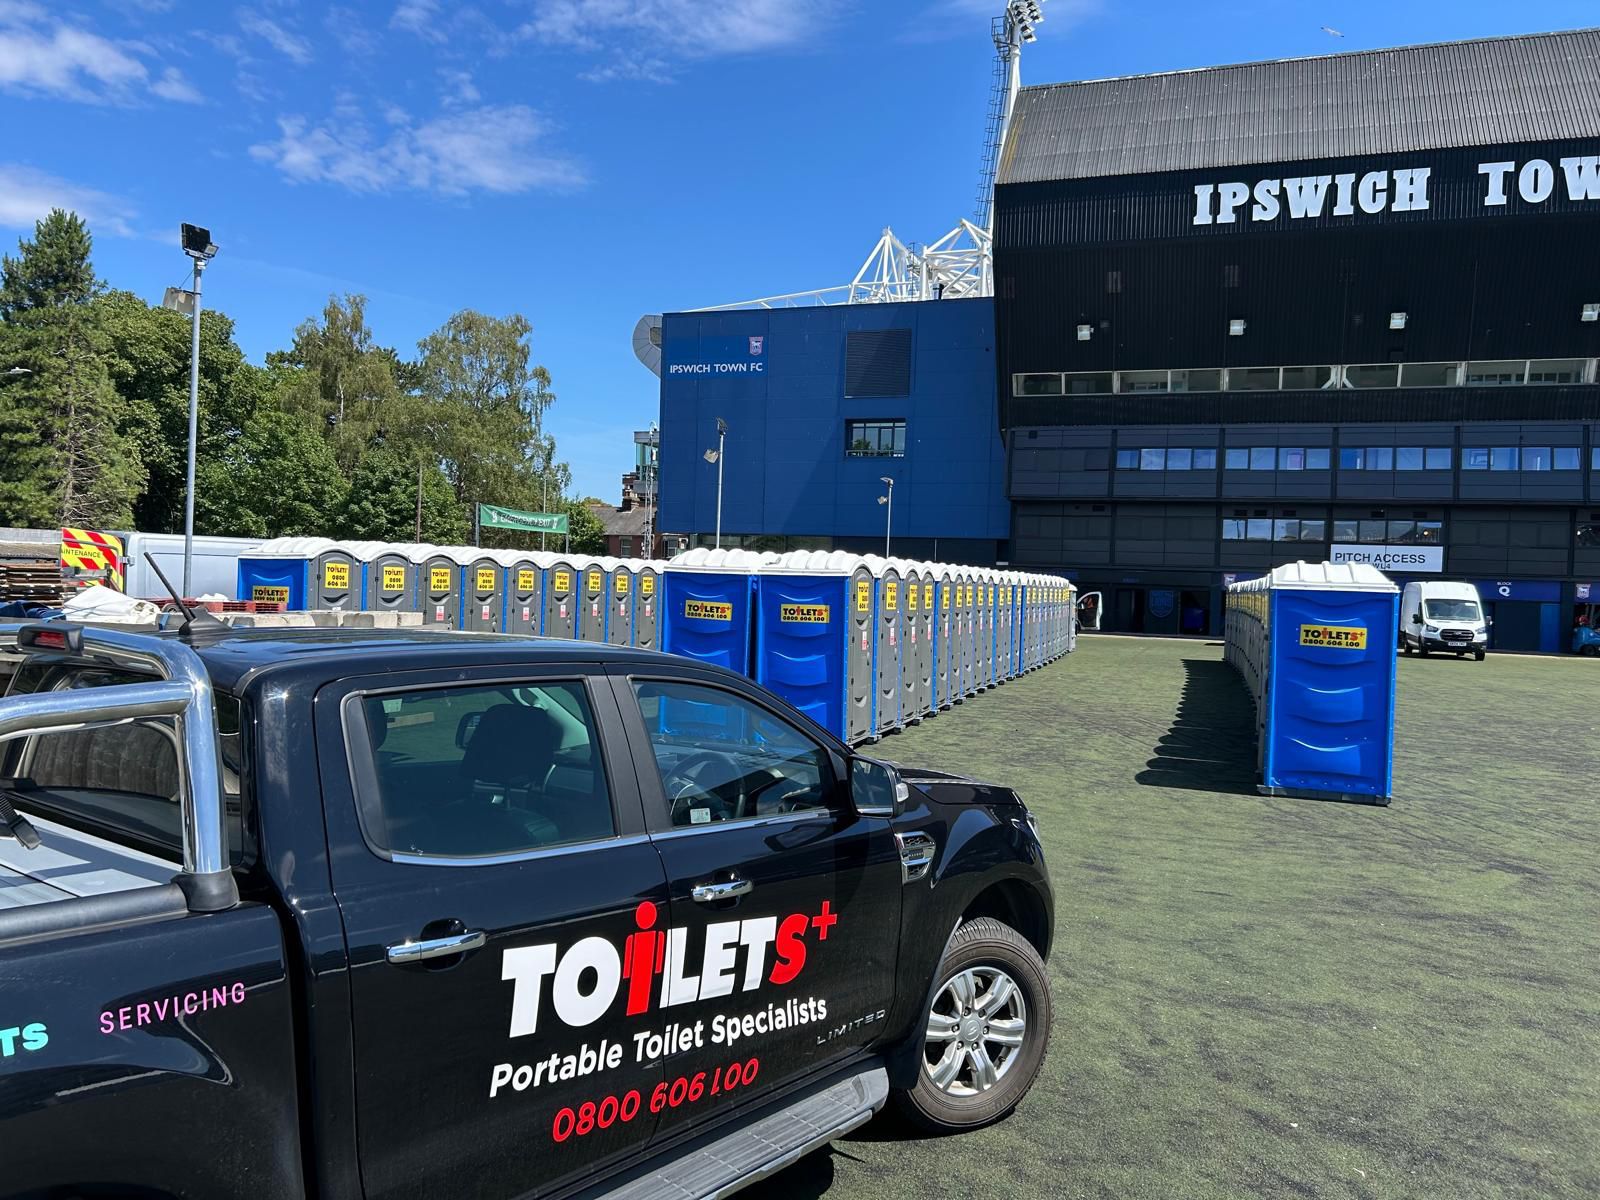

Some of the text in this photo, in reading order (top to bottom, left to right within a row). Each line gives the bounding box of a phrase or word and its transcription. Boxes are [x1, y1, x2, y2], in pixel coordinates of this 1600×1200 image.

[1192, 155, 1600, 226] IPSWICH TOW
[670, 362, 763, 374] IPSWICH TOWN FC
[1335, 552, 1426, 563] PITCH ACCESS
[1499, 586, 1511, 597] Q
[100, 982, 246, 1035] SERVICING
[0, 1022, 49, 1057] TS
[489, 996, 828, 1098] Portable Toilet Specialists
[816, 1009, 887, 1047] LIMITED
[552, 1058, 759, 1143] 0800 606 100
